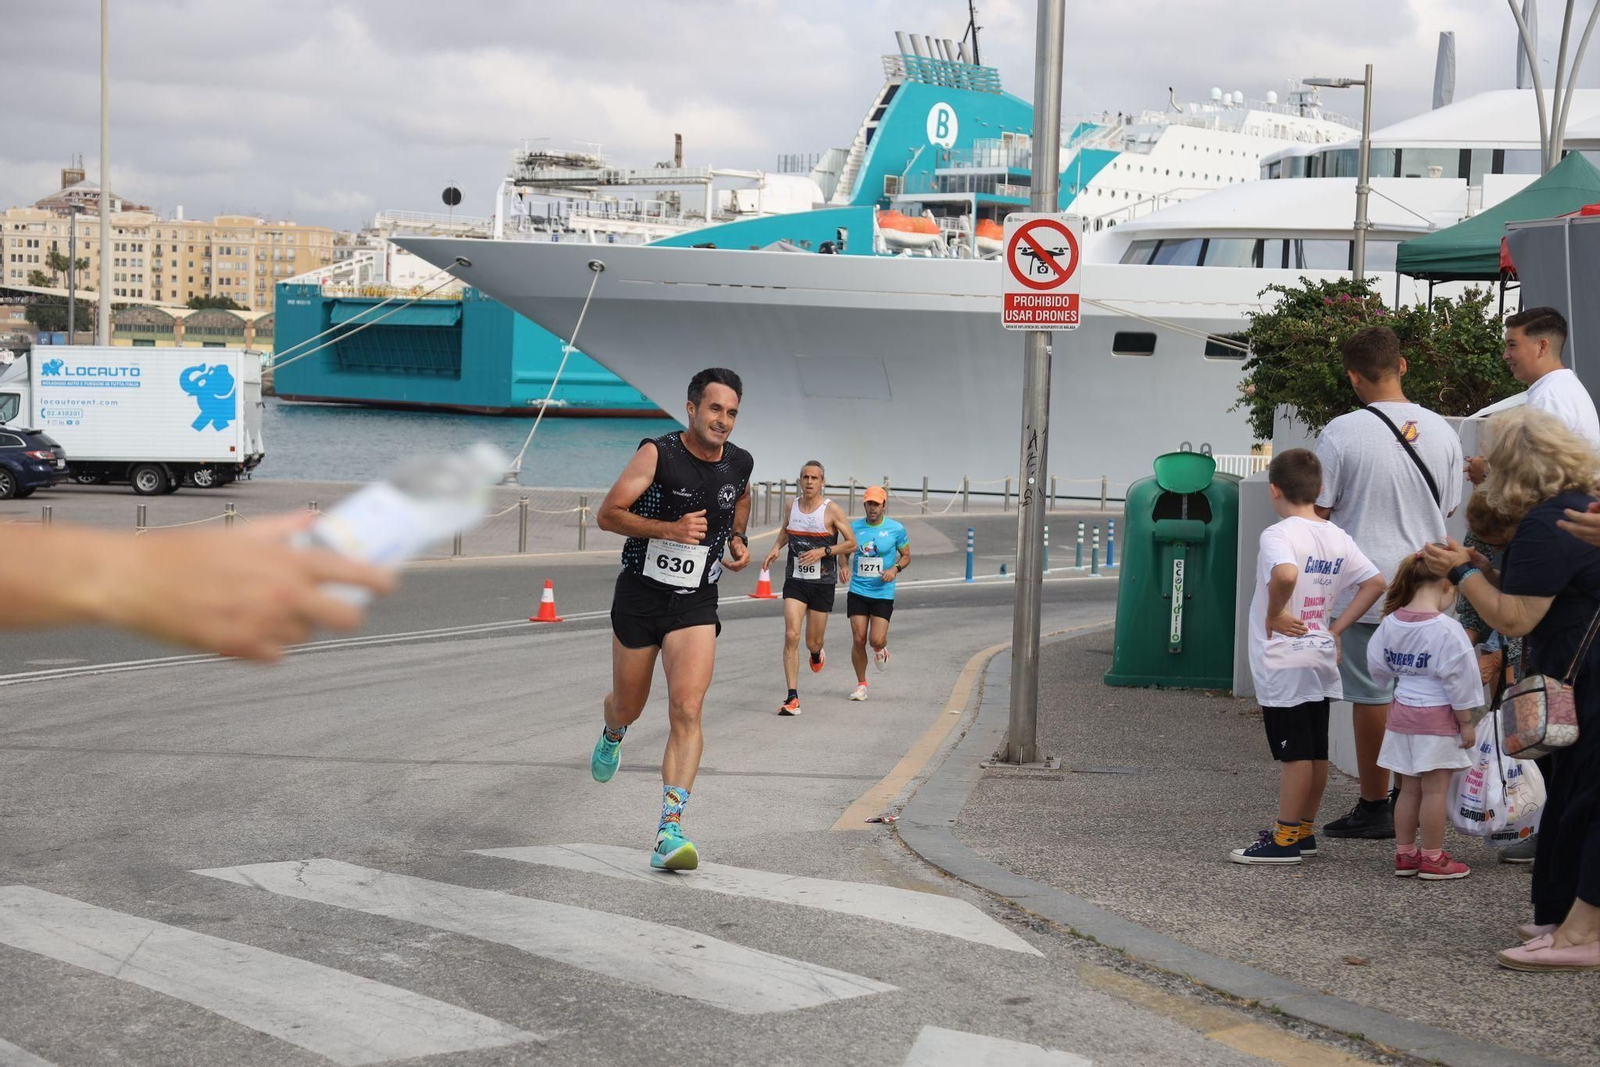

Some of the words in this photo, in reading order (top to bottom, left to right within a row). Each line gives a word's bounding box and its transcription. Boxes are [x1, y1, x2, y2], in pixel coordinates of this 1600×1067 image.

[936, 109, 949, 138] B
[1014, 296, 1069, 307] PROHIBIDO
[1005, 310, 1033, 321] USAR
[1035, 310, 1077, 321] DRONES
[65, 366, 140, 377] LOCAUTO
[40, 398, 118, 406] locautorent.com
[656, 554, 695, 574] 630
[798, 565, 815, 574] 596
[859, 564, 881, 572] 1271
[1172, 560, 1183, 641] ecovidrio
[1416, 652, 1432, 669] 5K
